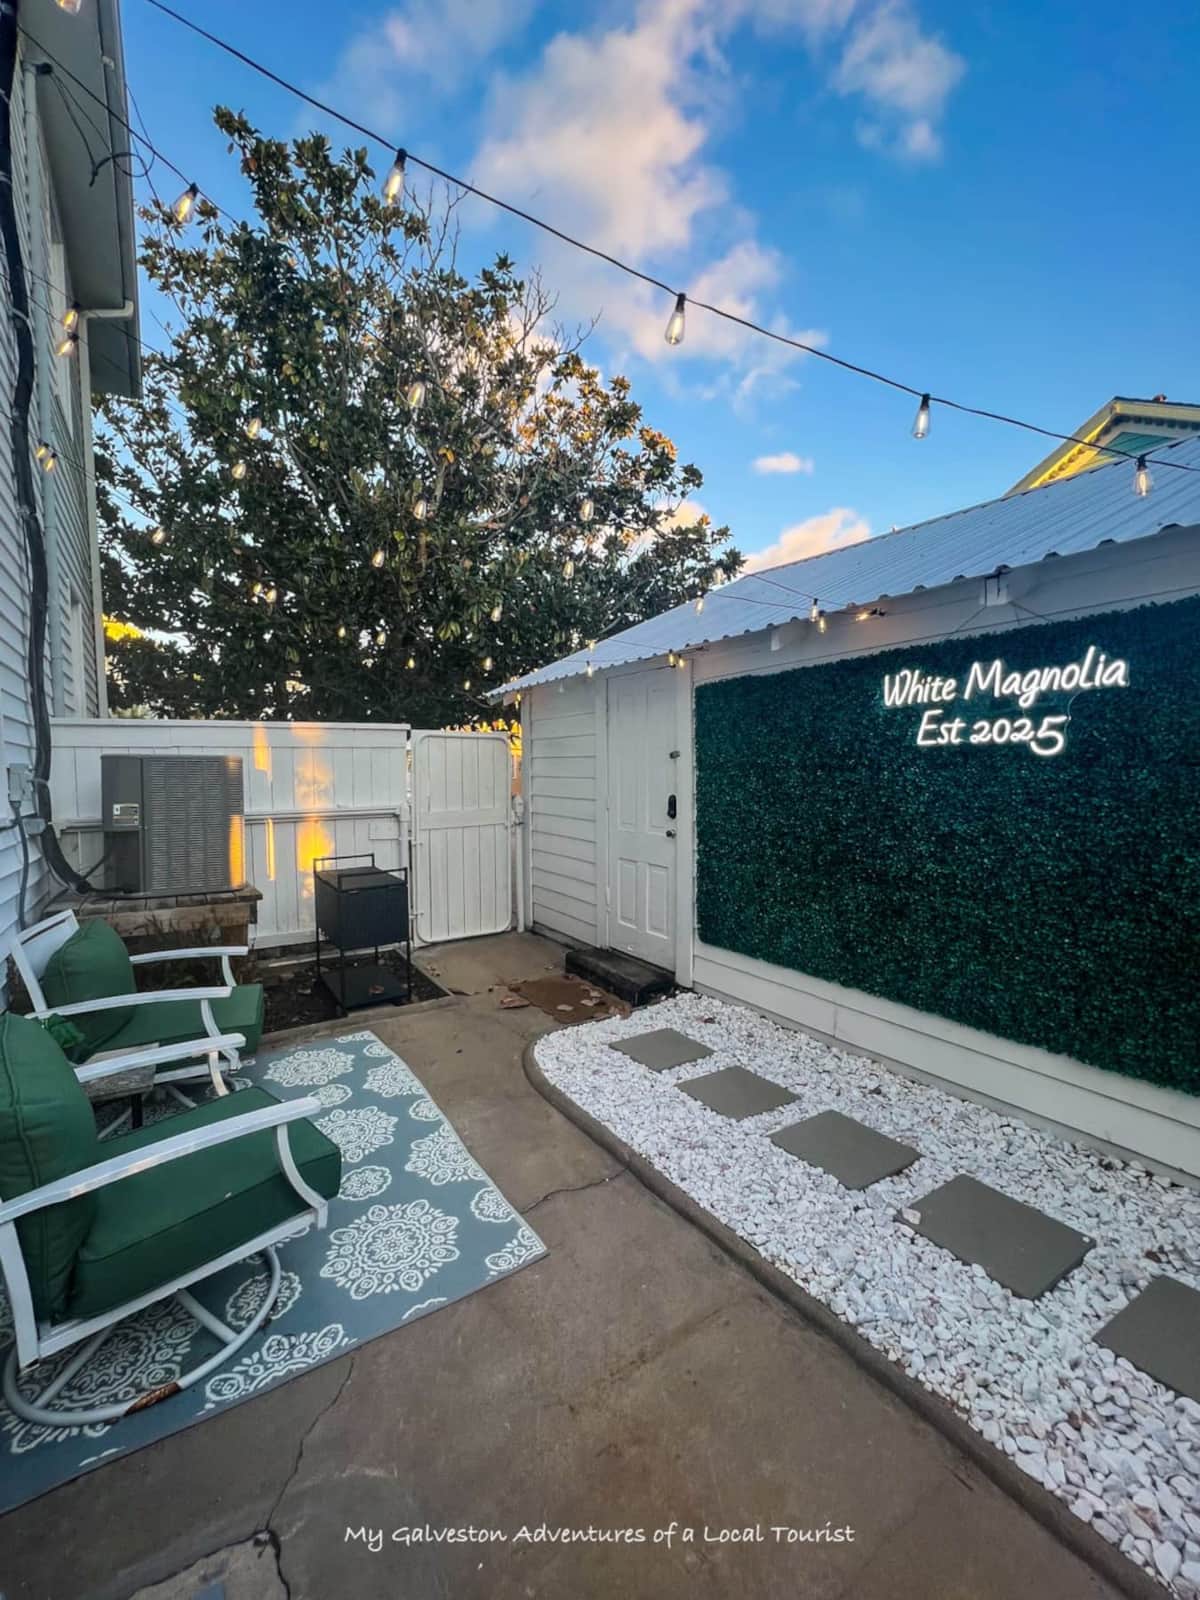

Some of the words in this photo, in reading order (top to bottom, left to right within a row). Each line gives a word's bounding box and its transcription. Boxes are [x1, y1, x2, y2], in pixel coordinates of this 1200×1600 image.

[884, 669, 957, 707] White
[963, 645, 1127, 708] Magnolia
[916, 709, 966, 746] Est
[969, 715, 1068, 756] 2025
